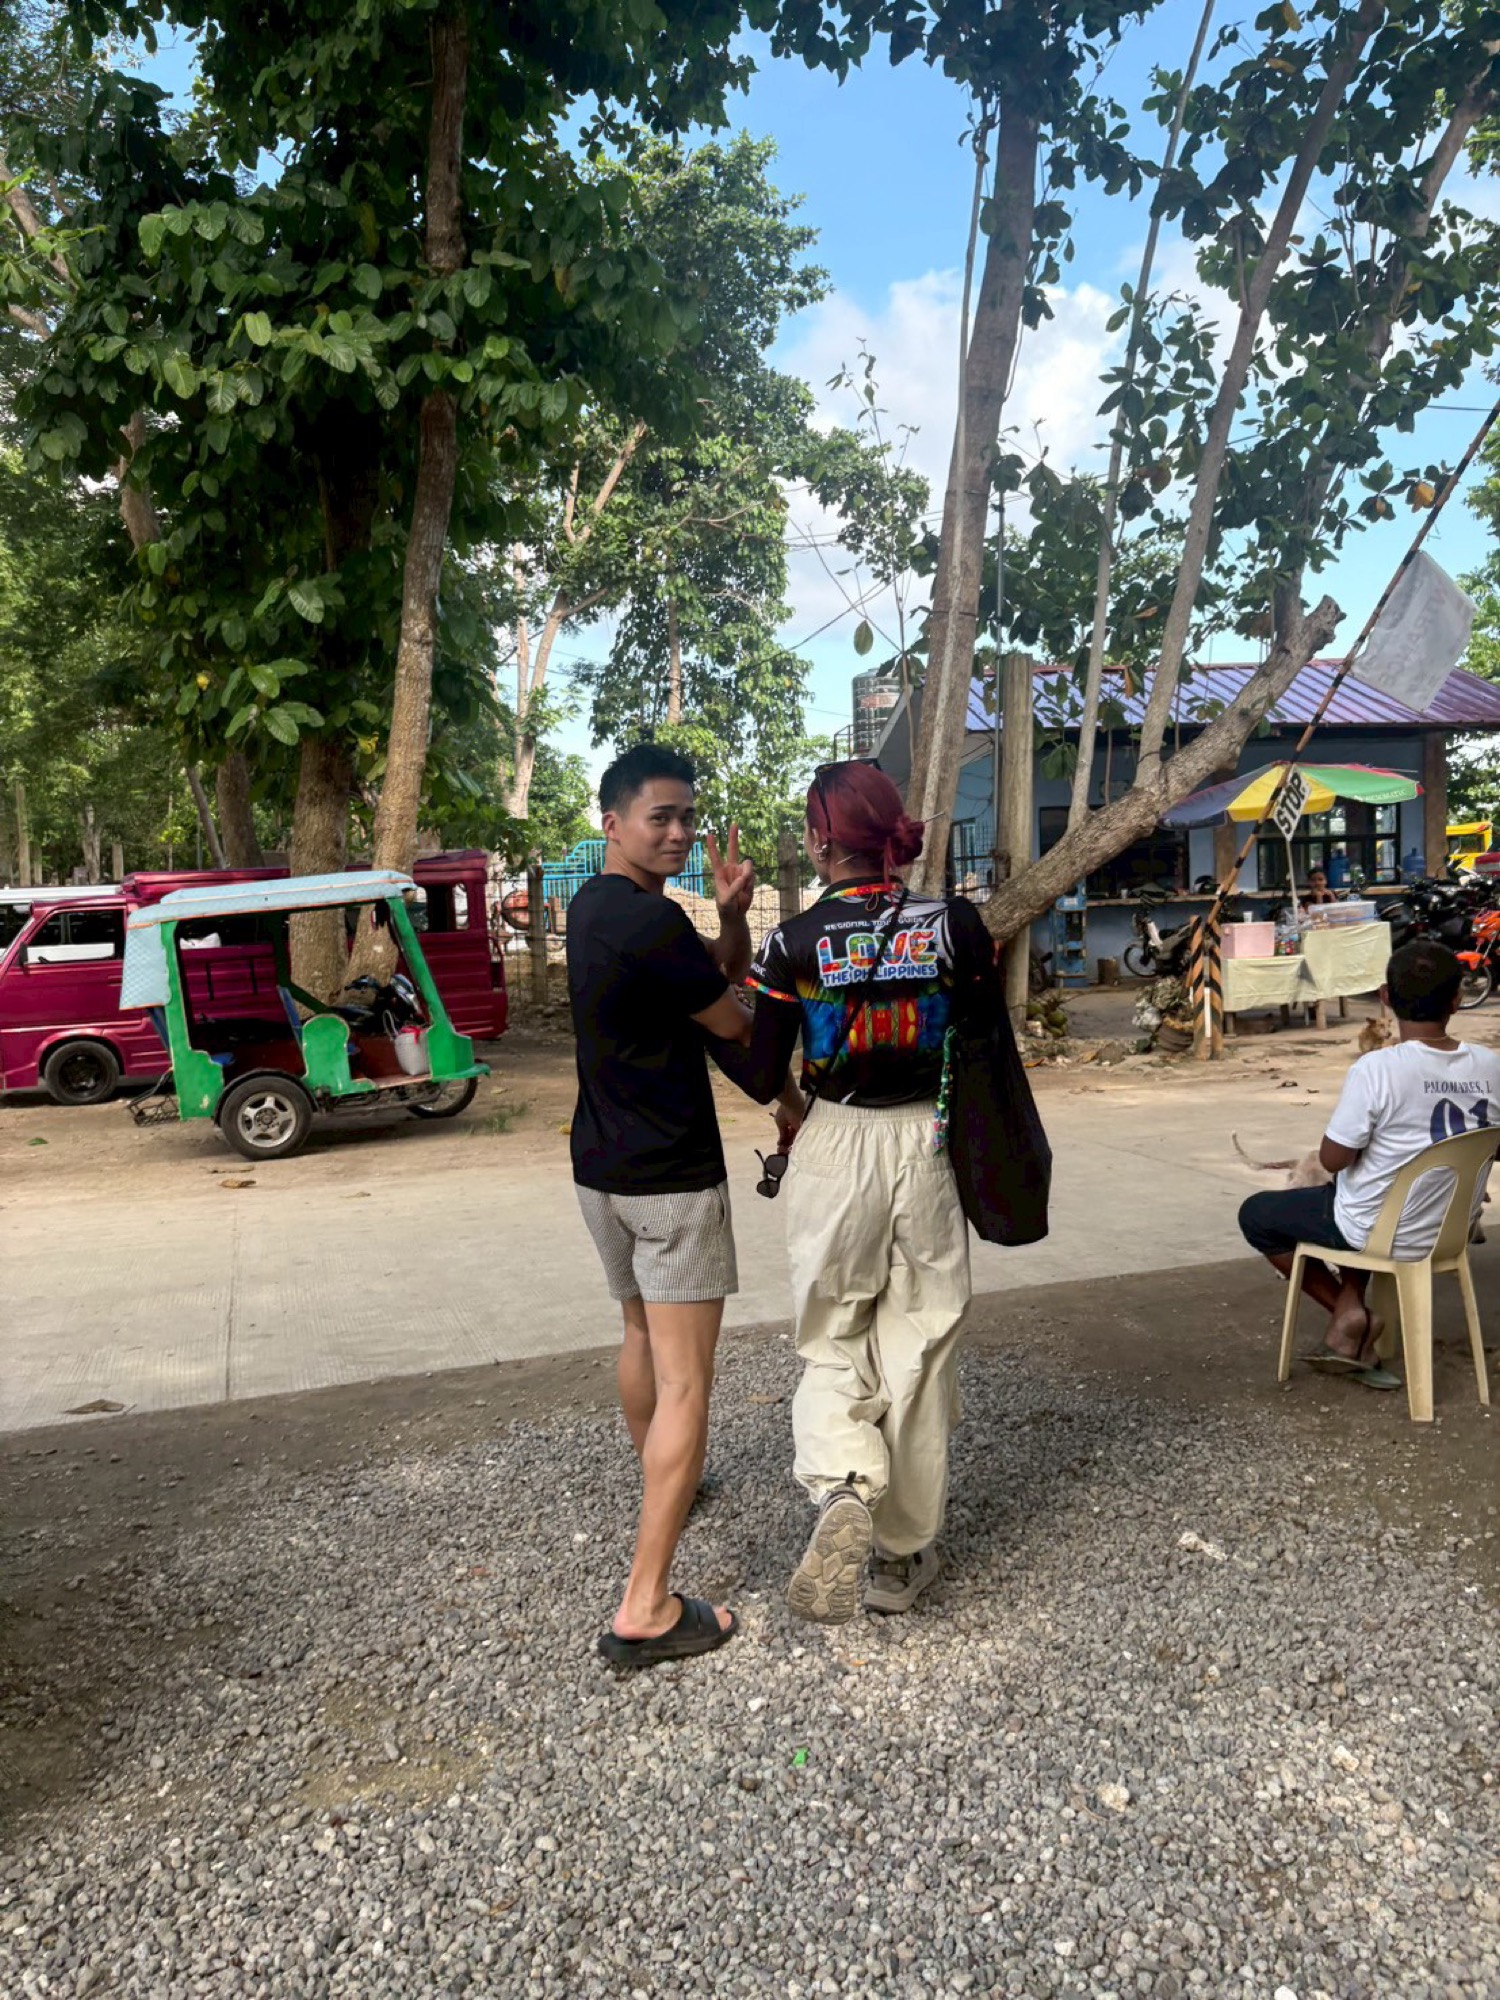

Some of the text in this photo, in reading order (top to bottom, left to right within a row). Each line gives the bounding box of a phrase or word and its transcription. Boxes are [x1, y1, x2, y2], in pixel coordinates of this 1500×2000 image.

[1277, 772, 1305, 834] STOP
[817, 929, 938, 975] LOVE
[822, 963, 938, 986] THE PHLIPPINES
